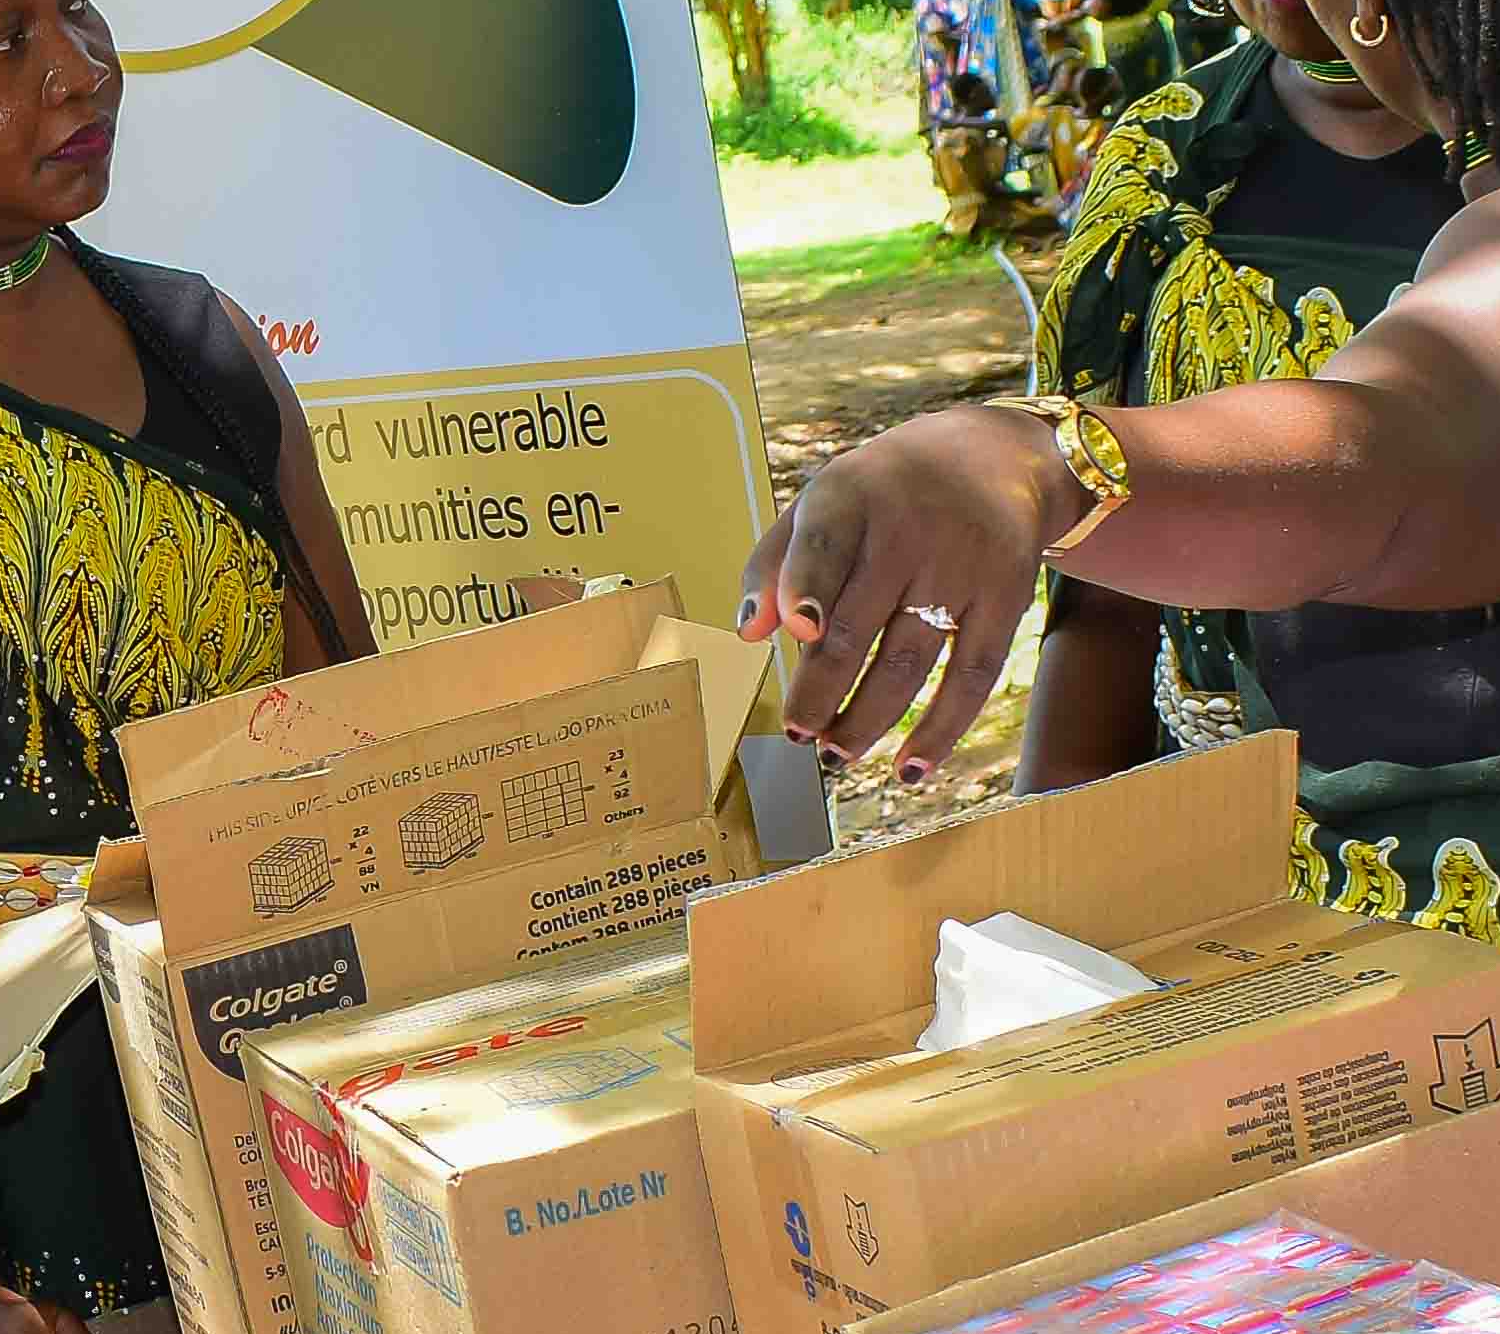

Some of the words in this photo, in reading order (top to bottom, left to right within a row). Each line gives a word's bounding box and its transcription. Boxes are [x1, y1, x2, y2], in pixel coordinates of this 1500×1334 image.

[258, 313, 320, 357] ion
[375, 390, 609, 460] vulnerable
[335, 486, 529, 547] munities
[546, 489, 622, 537] en-
[381, 765, 423, 793] VERS
[424, 760, 444, 778] LE
[445, 733, 535, 774] HAUT/ESTE
[628, 697, 673, 722] CIMA
[608, 748, 625, 762] 23
[619, 769, 630, 781] 4
[352, 826, 369, 838] 22
[603, 804, 645, 825] Others
[364, 845, 374, 856] 4
[360, 880, 381, 895] VN
[530, 875, 604, 912] Contain
[606, 863, 643, 891] 288
[646, 847, 707, 886] pieces
[527, 903, 610, 939] Contient
[610, 888, 650, 915] 288
[653, 873, 713, 909] pièces
[504, 1207, 532, 1236] B.
[536, 1182, 636, 1228] No./Lote
[640, 1170, 668, 1198] Nr
